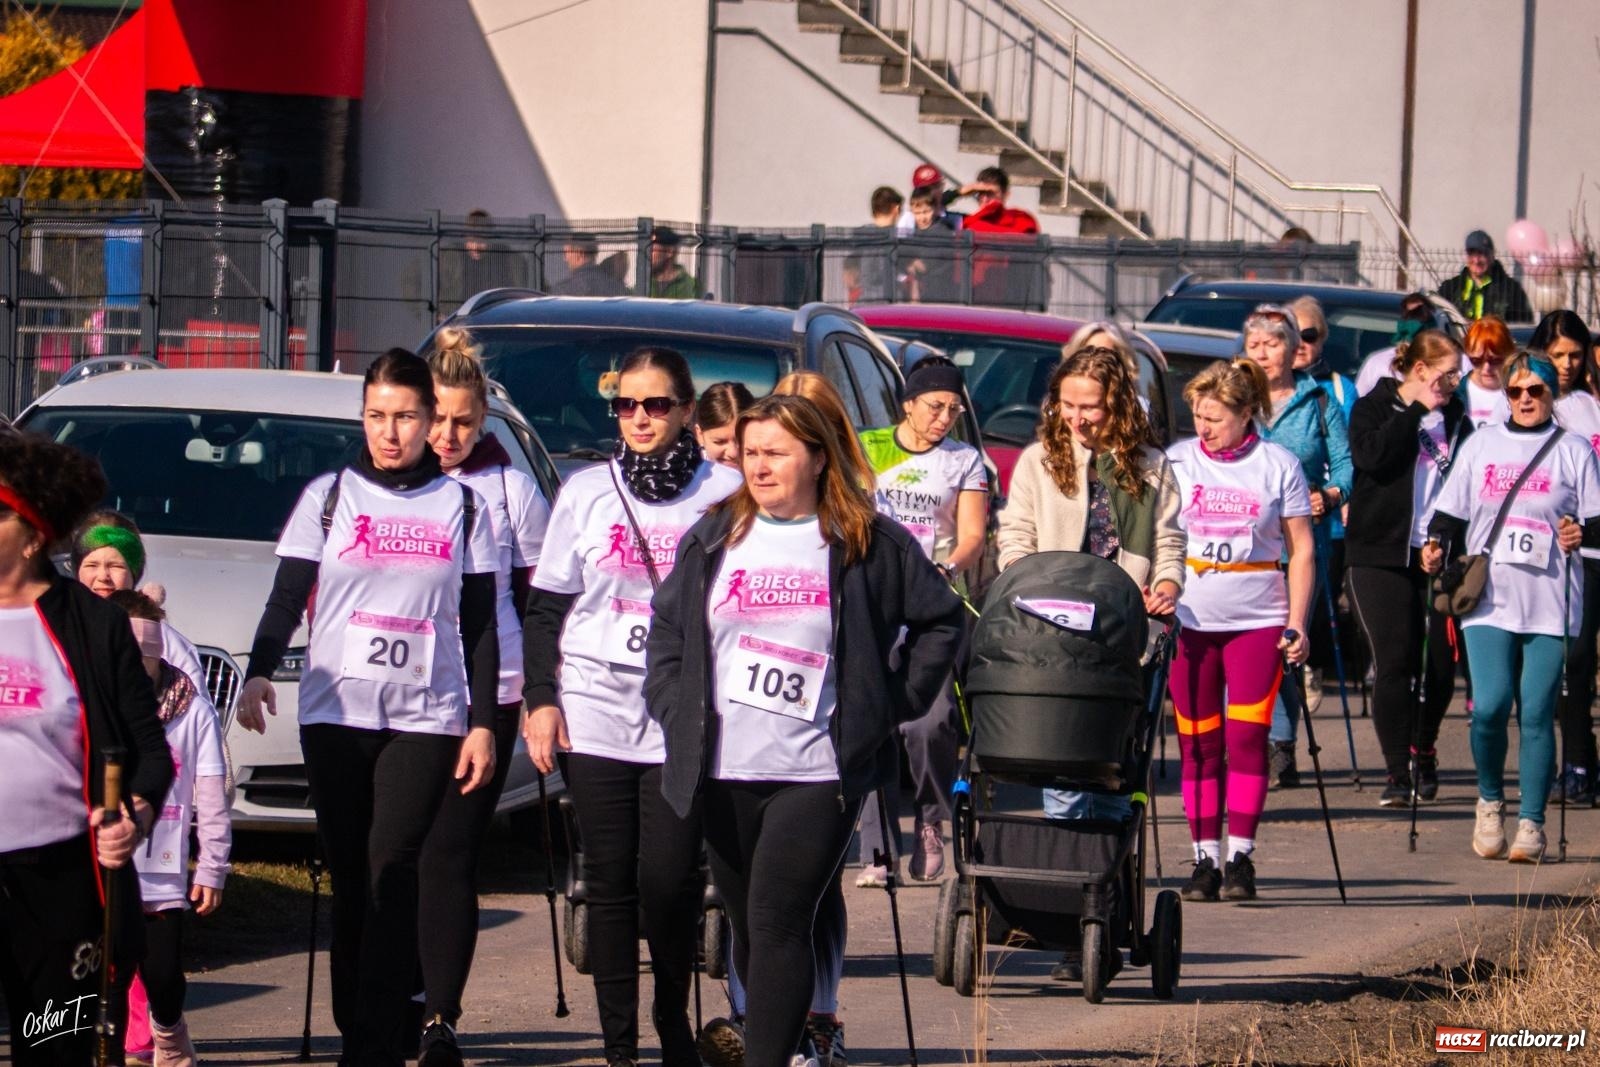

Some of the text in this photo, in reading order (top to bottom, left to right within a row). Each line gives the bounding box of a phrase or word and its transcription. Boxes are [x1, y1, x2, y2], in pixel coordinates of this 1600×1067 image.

[1497, 467, 1522, 480] BIE
[885, 488, 942, 507] KTYWNI
[1206, 489, 1239, 503] BIEG
[1207, 501, 1252, 514] KOBIET
[375, 523, 425, 539] BIEG
[378, 538, 445, 556] KOBIET
[629, 532, 675, 549] BEG
[1508, 532, 1534, 553] 16
[1201, 542, 1233, 563] 40
[749, 575, 801, 590] BIEG
[750, 590, 821, 605] KOBIET
[1040, 613, 1070, 625] 6
[367, 636, 410, 669] 20
[747, 662, 806, 704] 103
